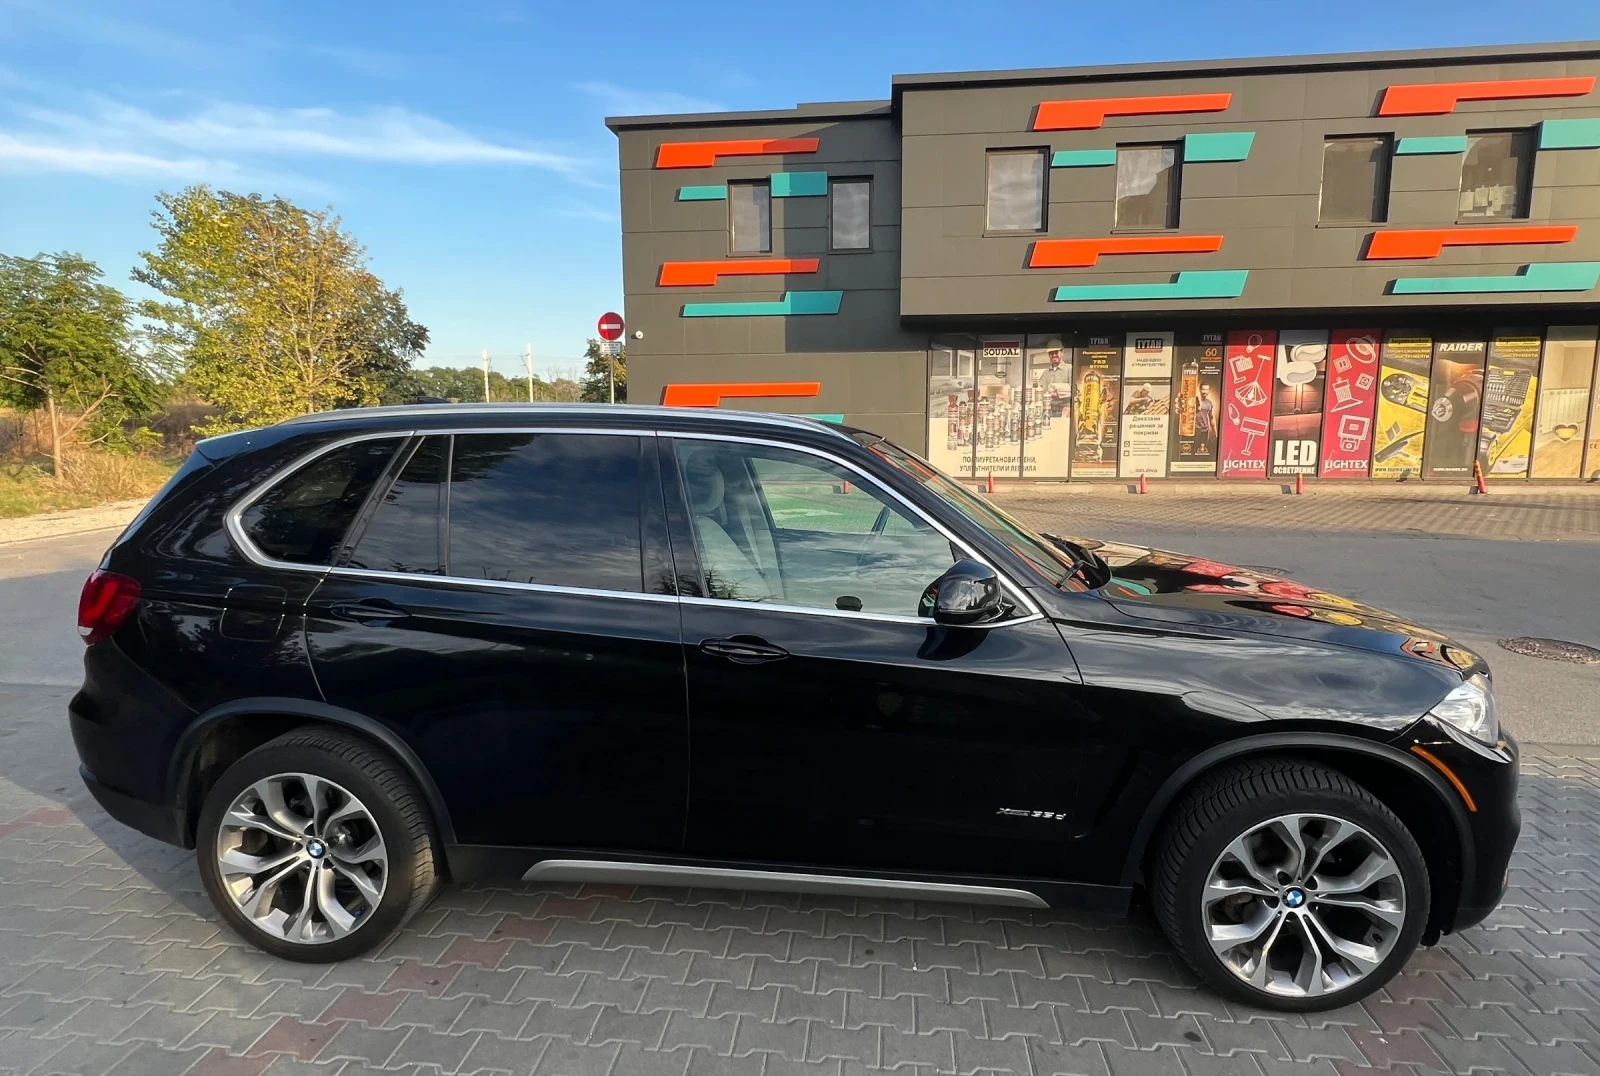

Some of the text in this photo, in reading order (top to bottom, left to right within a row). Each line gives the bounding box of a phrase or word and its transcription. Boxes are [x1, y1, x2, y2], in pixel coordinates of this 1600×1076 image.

[1137, 339, 1161, 349] TYTAN
[1439, 343, 1483, 352] RAIDER
[1205, 348, 1217, 356] 60
[1274, 440, 1317, 466] LED
[1224, 460, 1265, 469] LIGHTEX
[1324, 460, 1368, 469] LIGHTEX
